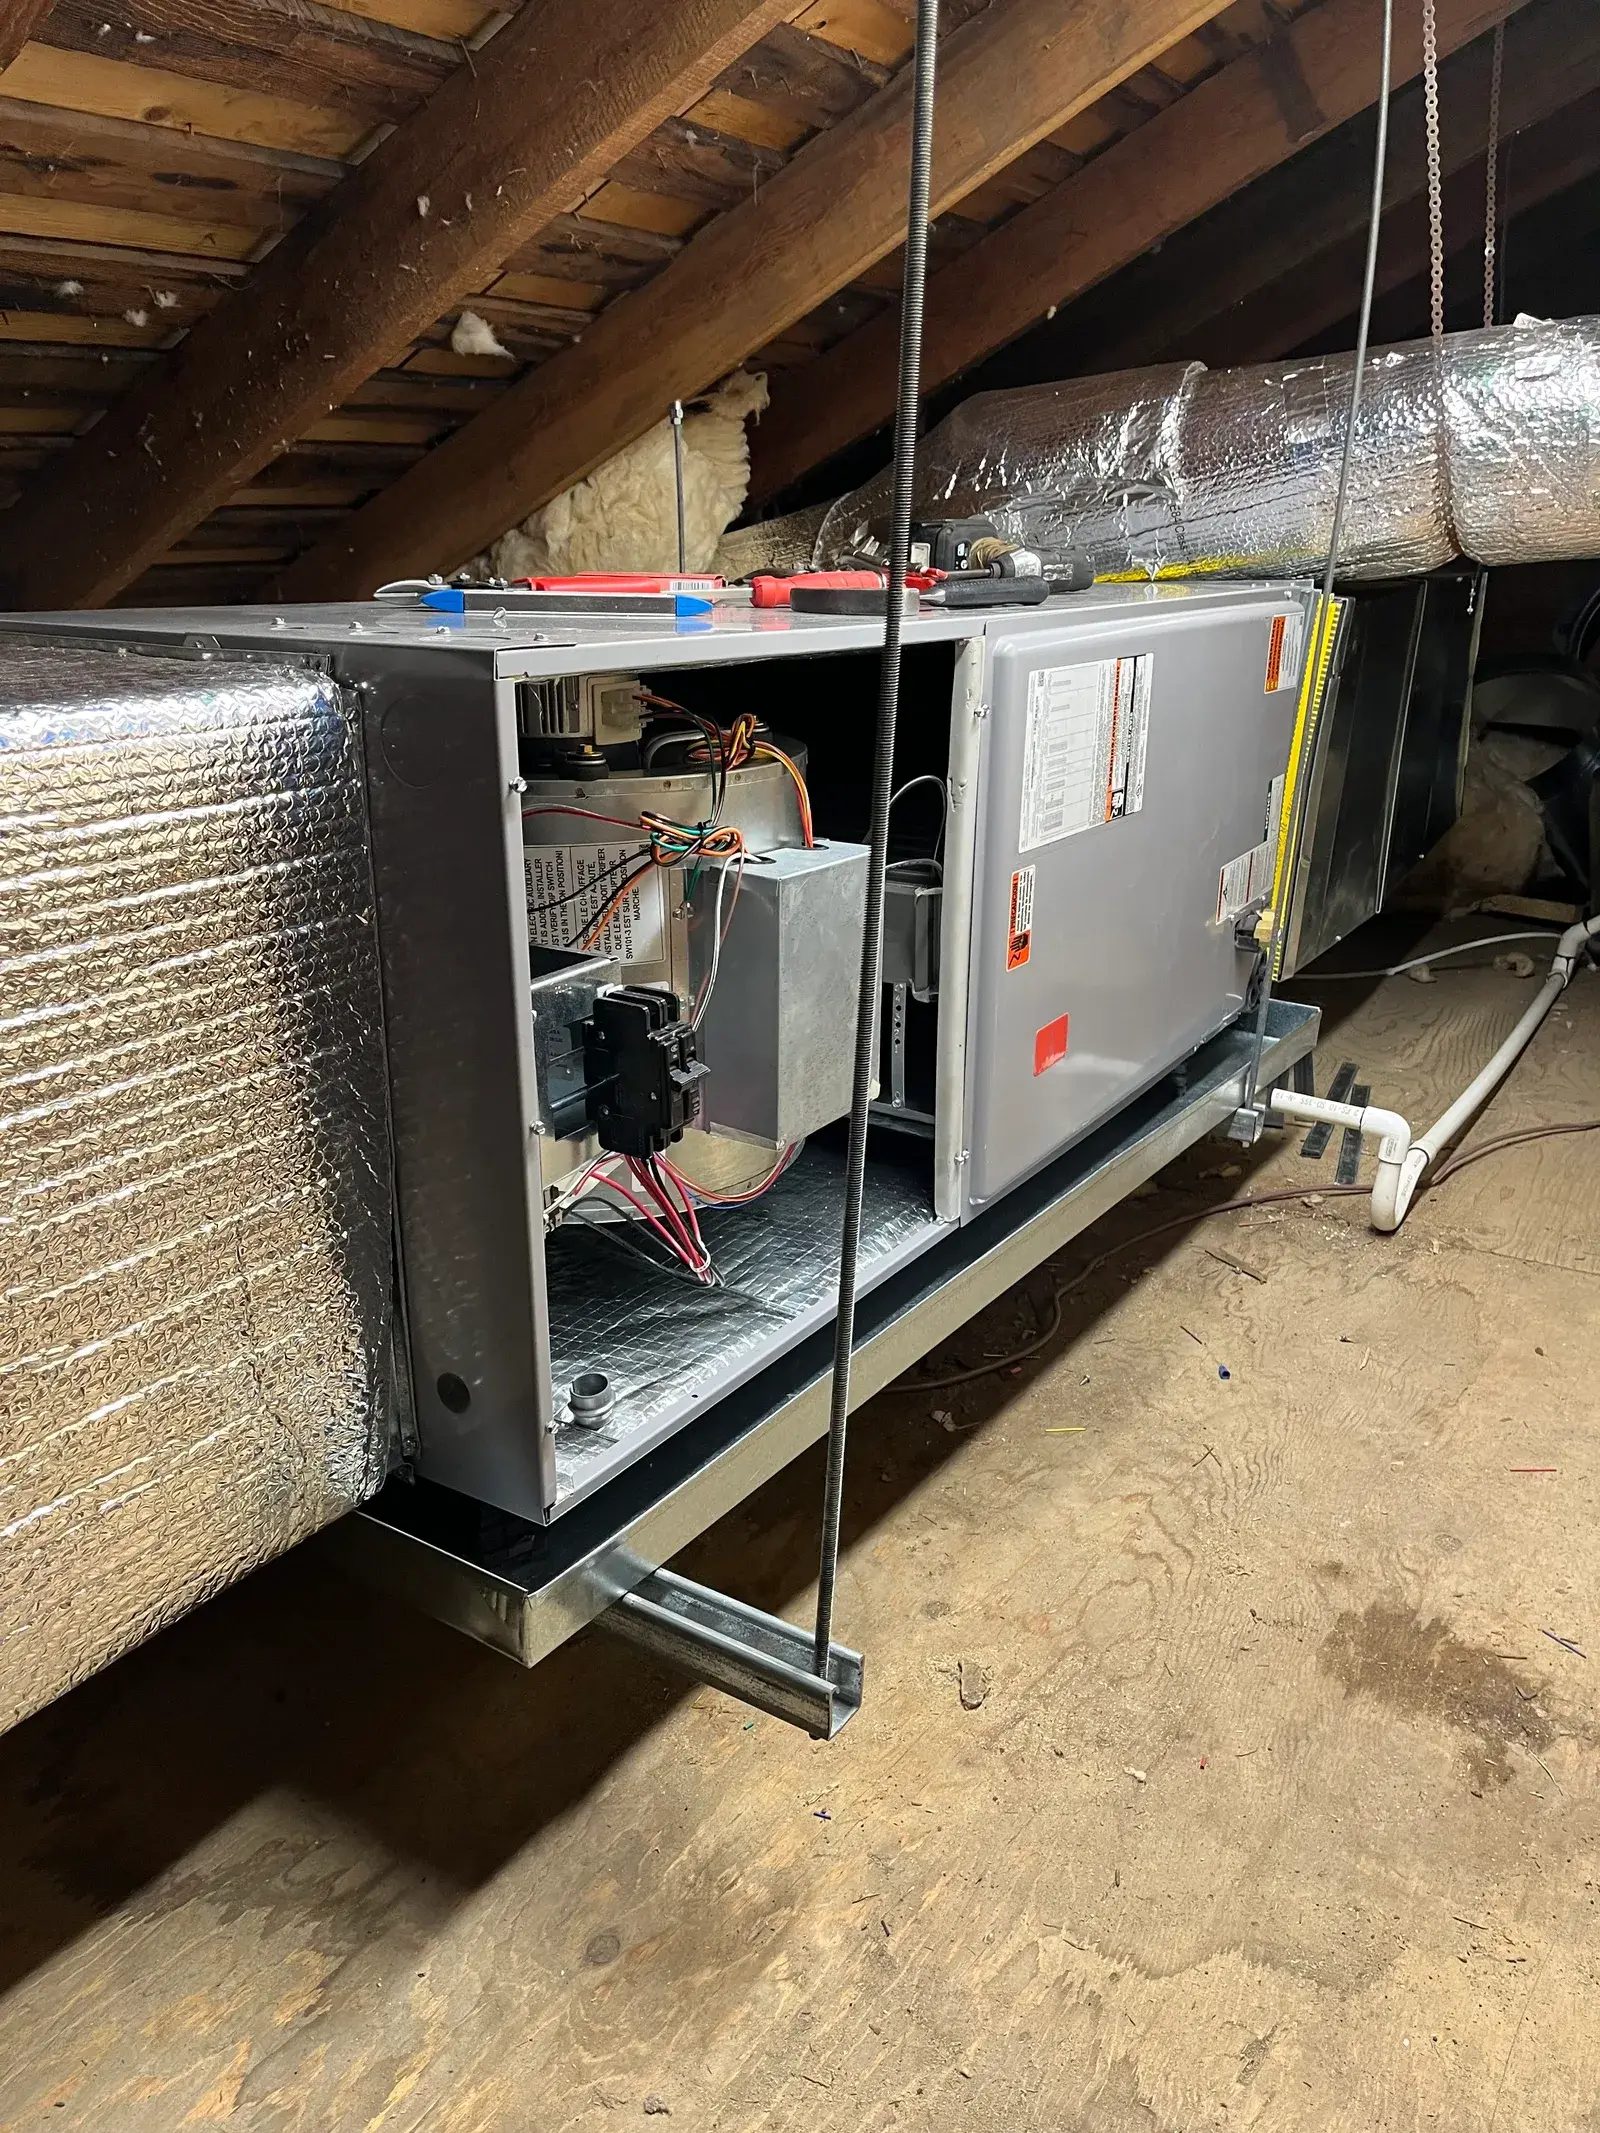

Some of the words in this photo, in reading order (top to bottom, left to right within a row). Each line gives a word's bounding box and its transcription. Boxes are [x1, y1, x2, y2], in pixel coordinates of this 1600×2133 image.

[1175, 525, 1189, 551] Class
[535, 858, 544, 899] INSTALLER
[546, 861, 555, 891] SWITCH
[601, 884, 609, 901] DOIT
[631, 887, 641, 920] MARCHE.
[581, 908, 588, 918] LE
[561, 919, 568, 928] IN
[562, 928, 569, 936] IS
[613, 924, 621, 935] LE
[614, 936, 622, 951] QUE
[625, 930, 634, 960] SW101-3
